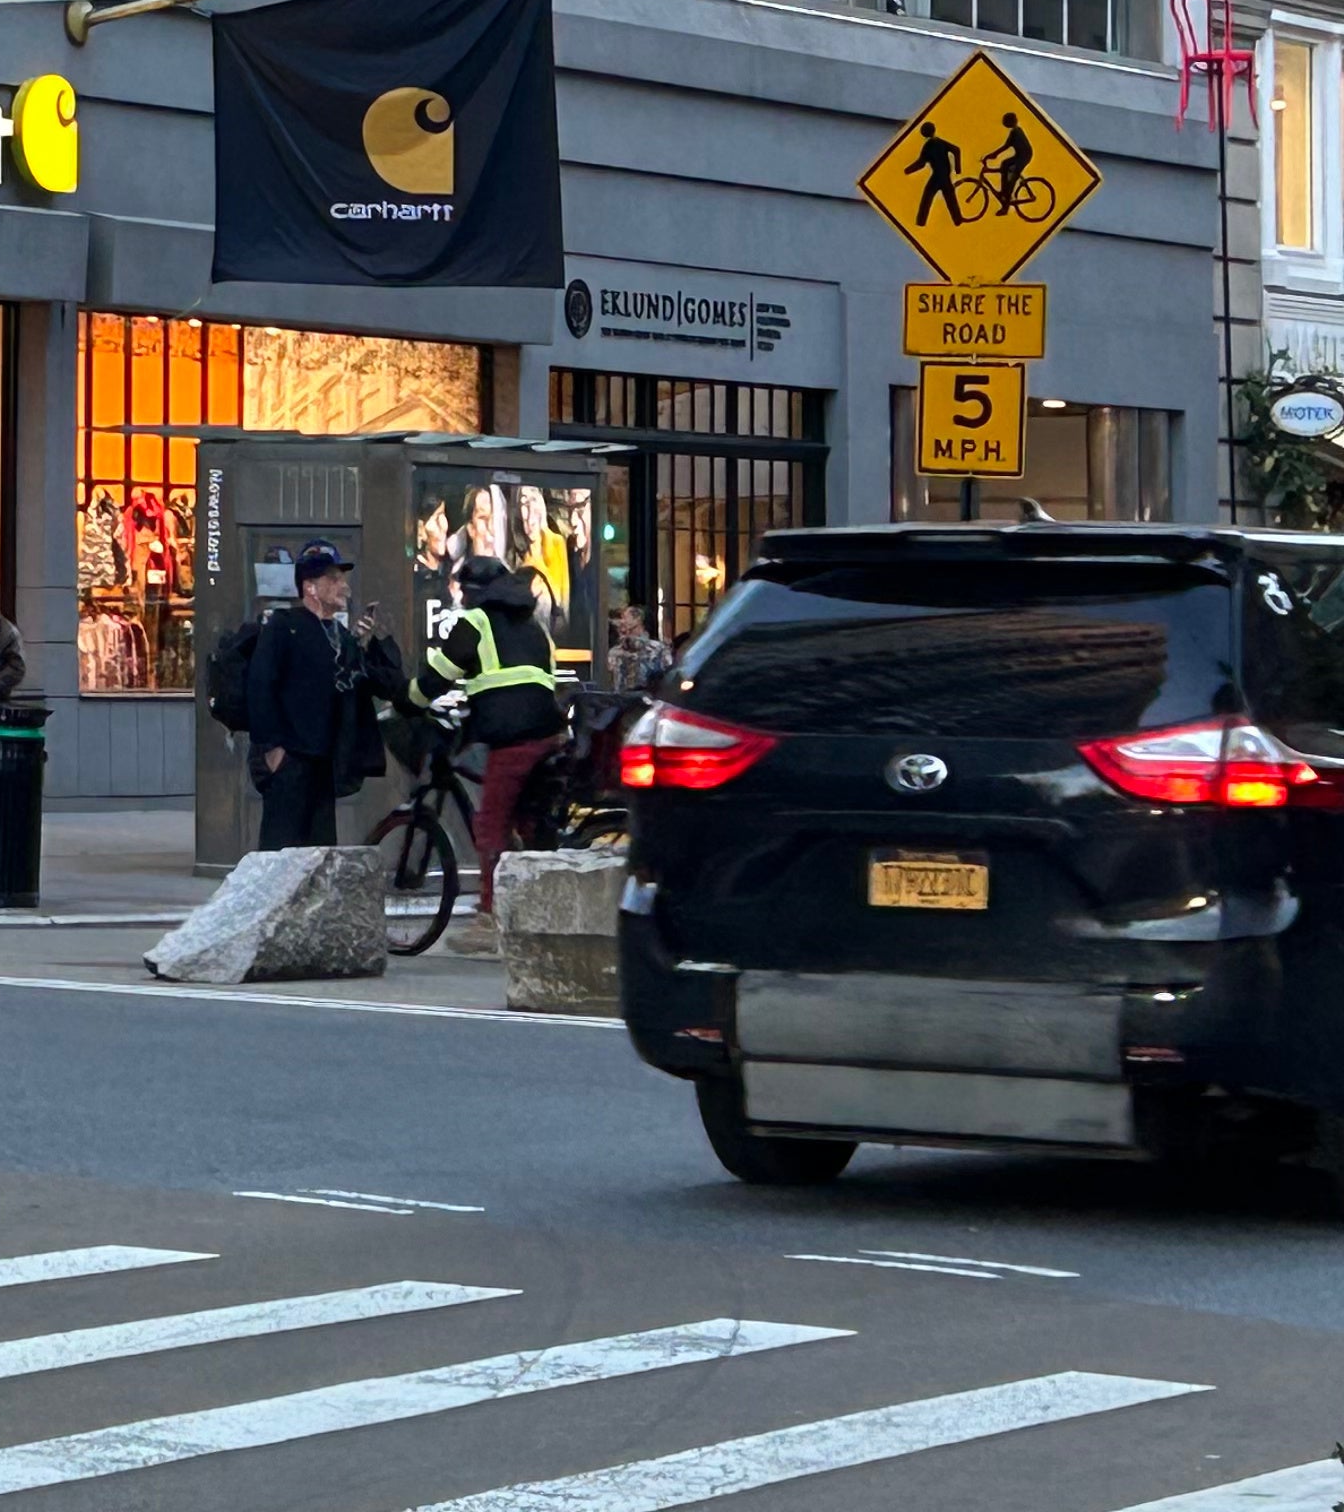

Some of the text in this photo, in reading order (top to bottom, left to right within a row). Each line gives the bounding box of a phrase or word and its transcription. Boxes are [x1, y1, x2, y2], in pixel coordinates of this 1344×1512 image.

[330, 200, 454, 222] carhartt
[918, 292, 1033, 316] SHARE THE
[942, 322, 1007, 345] ROAD
[952, 374, 993, 429] 5
